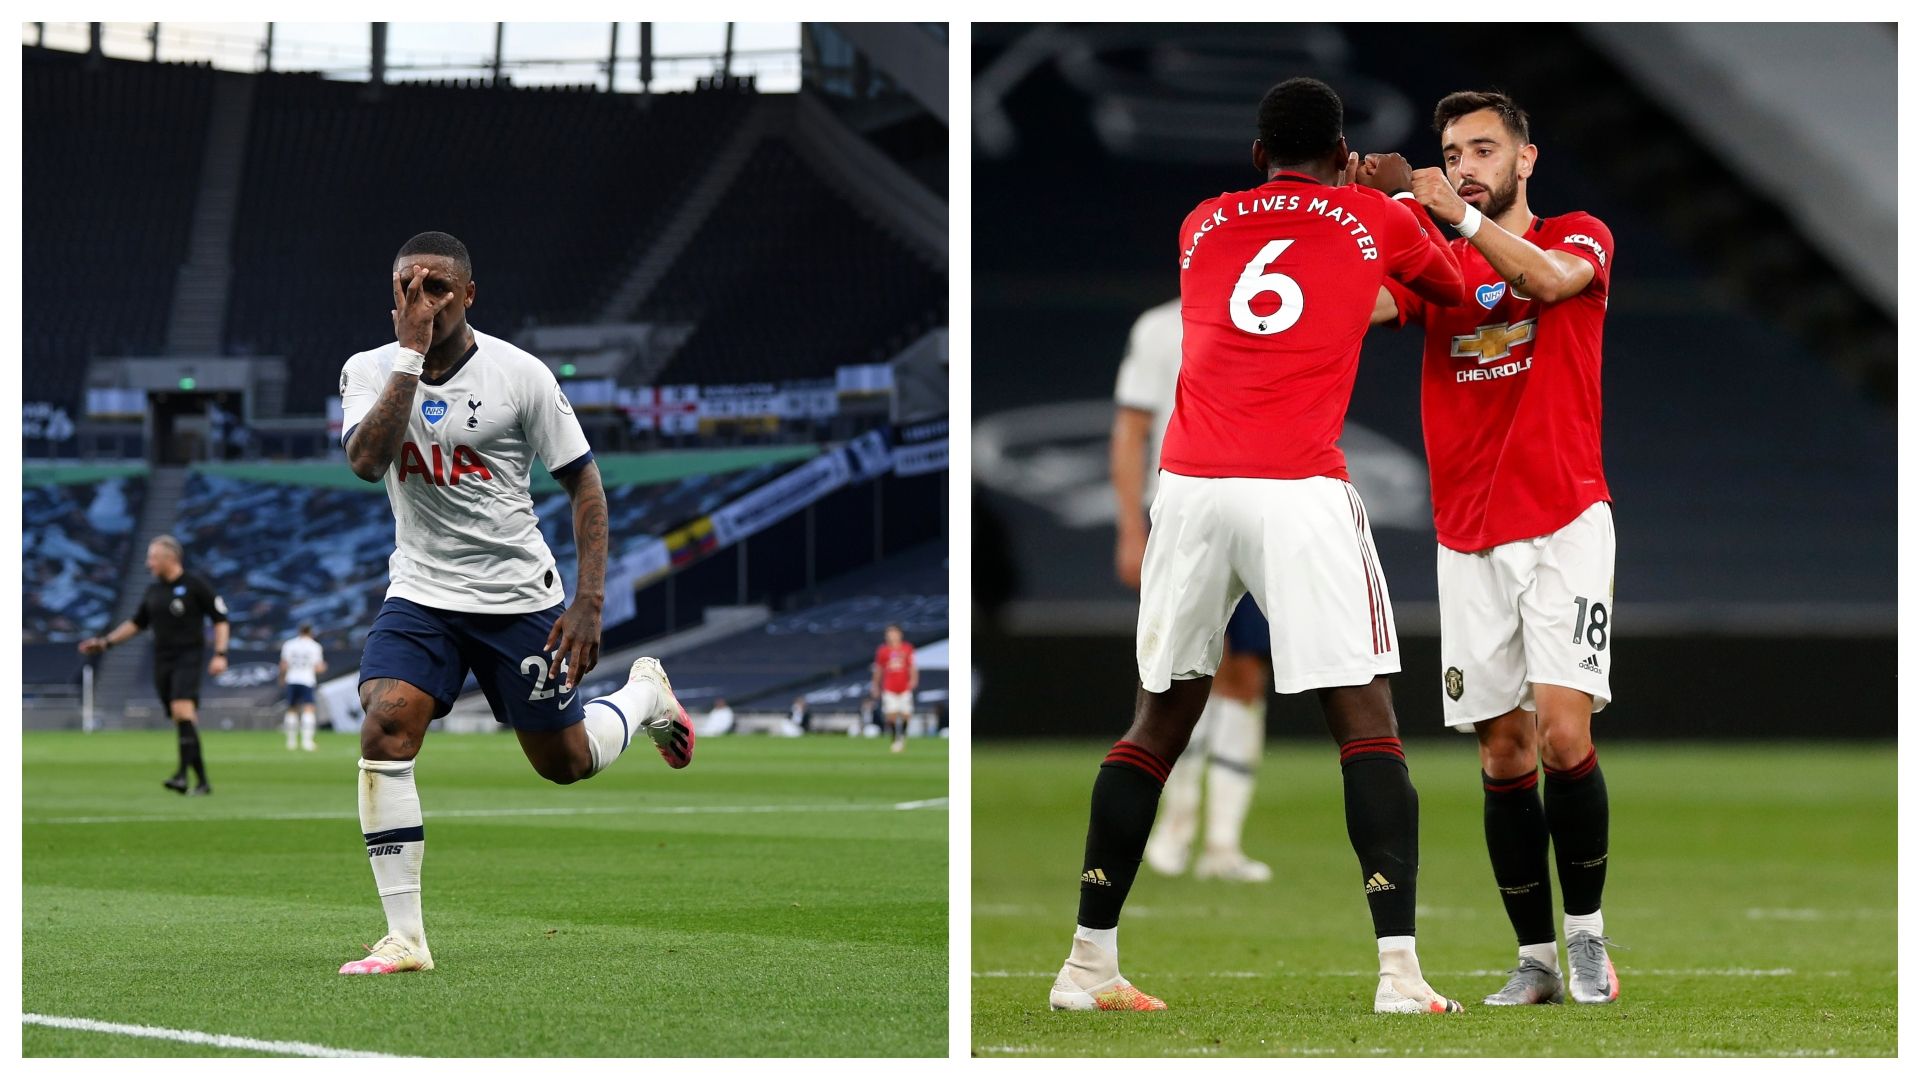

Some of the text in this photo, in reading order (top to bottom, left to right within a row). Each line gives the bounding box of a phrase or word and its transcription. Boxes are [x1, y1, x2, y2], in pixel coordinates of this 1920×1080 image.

[1182, 195, 1378, 269] BLACK LIVES MATTER
[1563, 233, 1606, 268] KOHLE
[1229, 239, 1304, 335] 6
[1483, 288, 1502, 302] NHS
[1457, 357, 1533, 382] CHEVROL
[426, 407, 443, 415] NHS
[399, 441, 492, 486] AIA
[1573, 596, 1607, 651] 18
[1579, 662, 1602, 674] adidas
[1081, 877, 1111, 886] adidas
[1366, 884, 1395, 893] adidas
